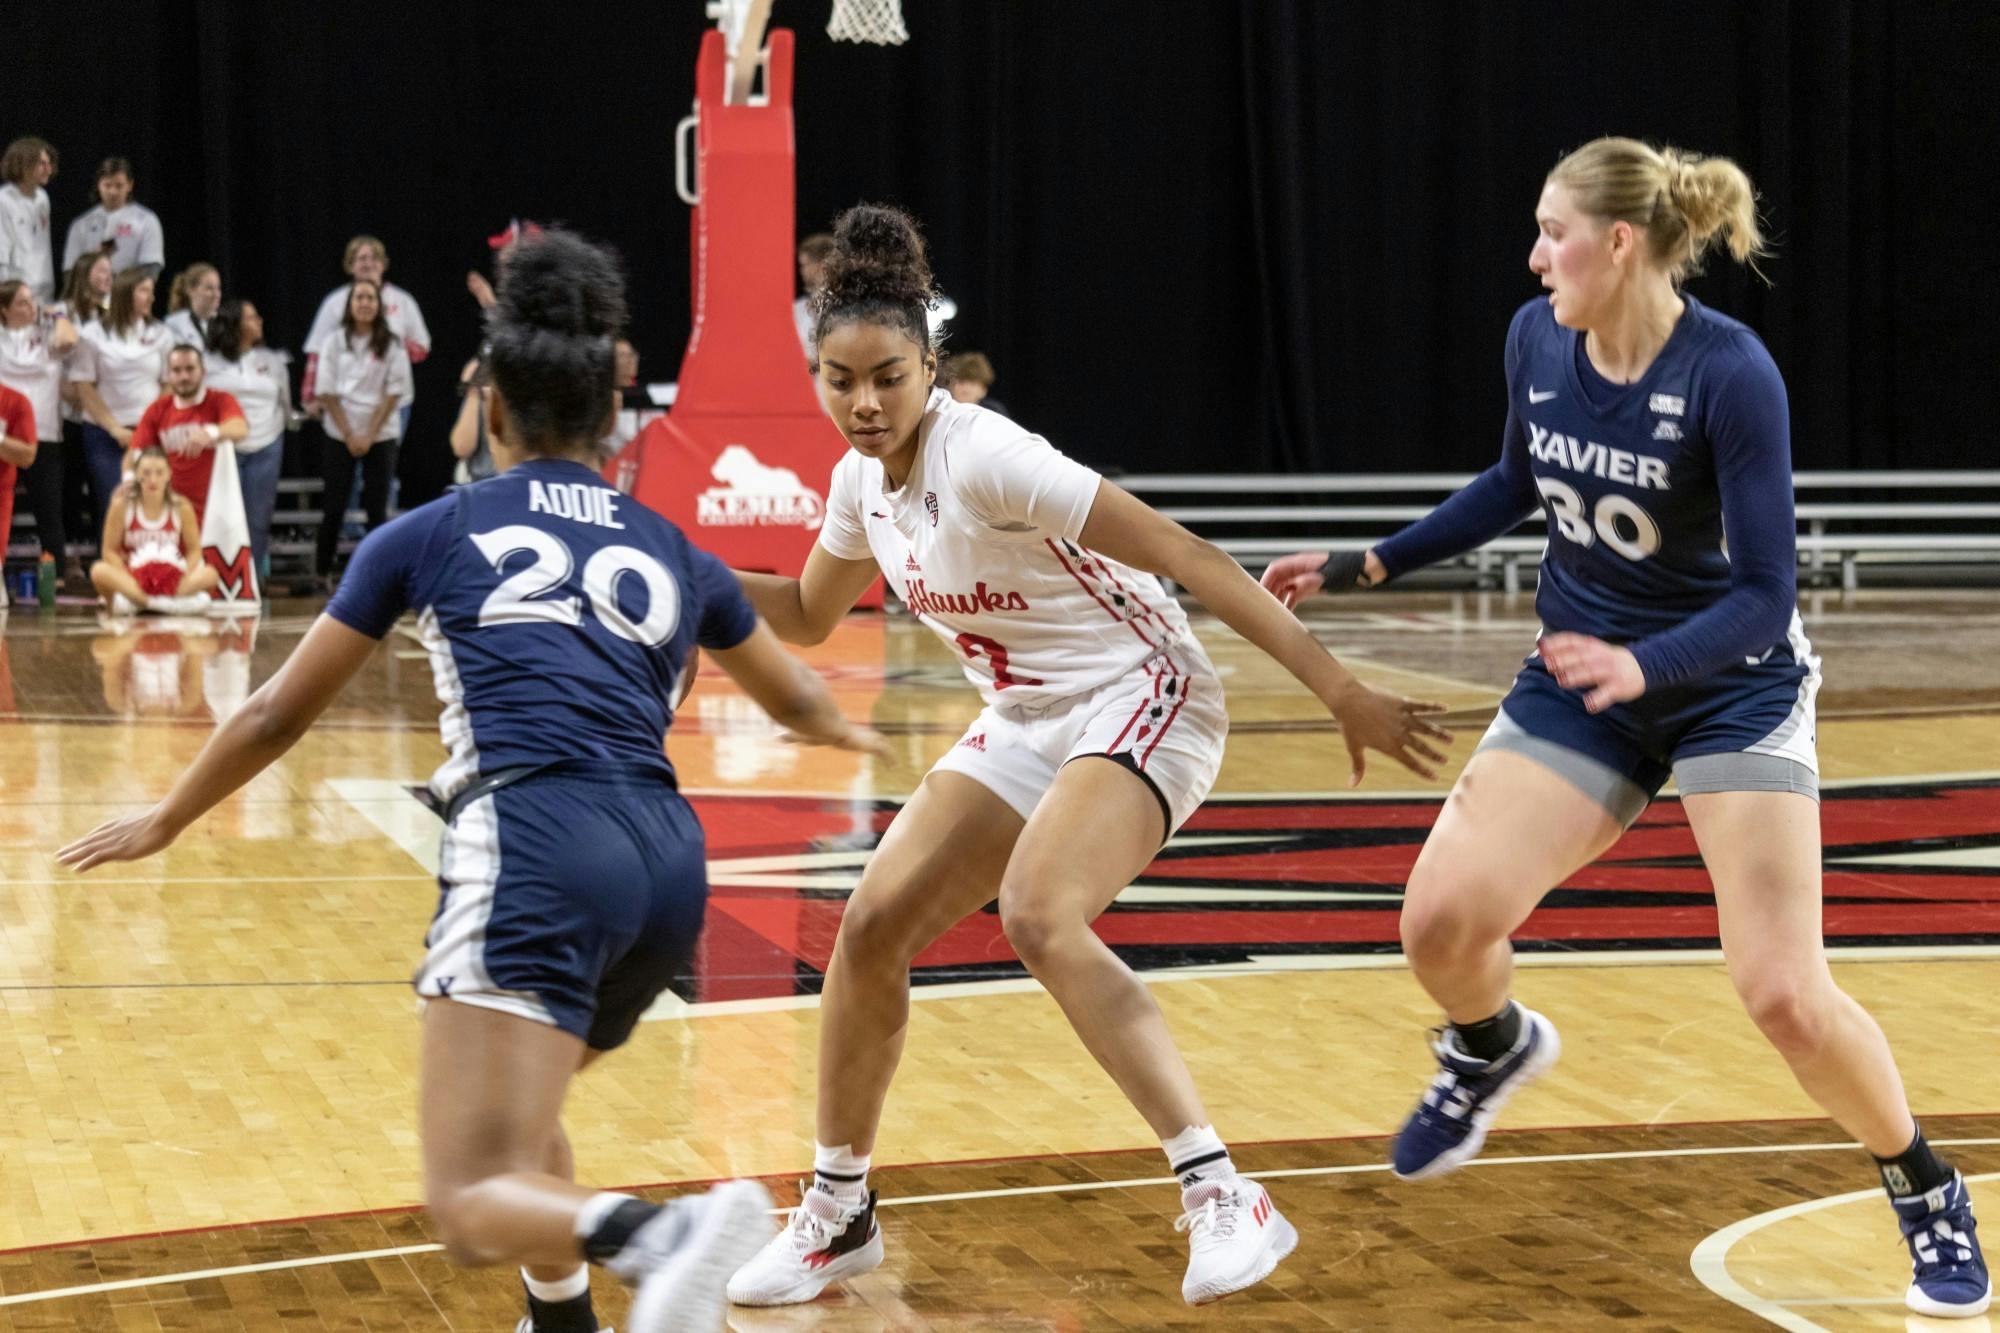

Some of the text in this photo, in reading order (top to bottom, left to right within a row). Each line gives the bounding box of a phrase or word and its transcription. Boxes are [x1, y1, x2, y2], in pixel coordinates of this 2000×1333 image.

[1528, 421, 1672, 490] XAVIER
[529, 480, 625, 529] ADDIE
[1535, 474, 1662, 561] 30
[203, 545, 256, 600] M
[468, 525, 682, 649] 20
